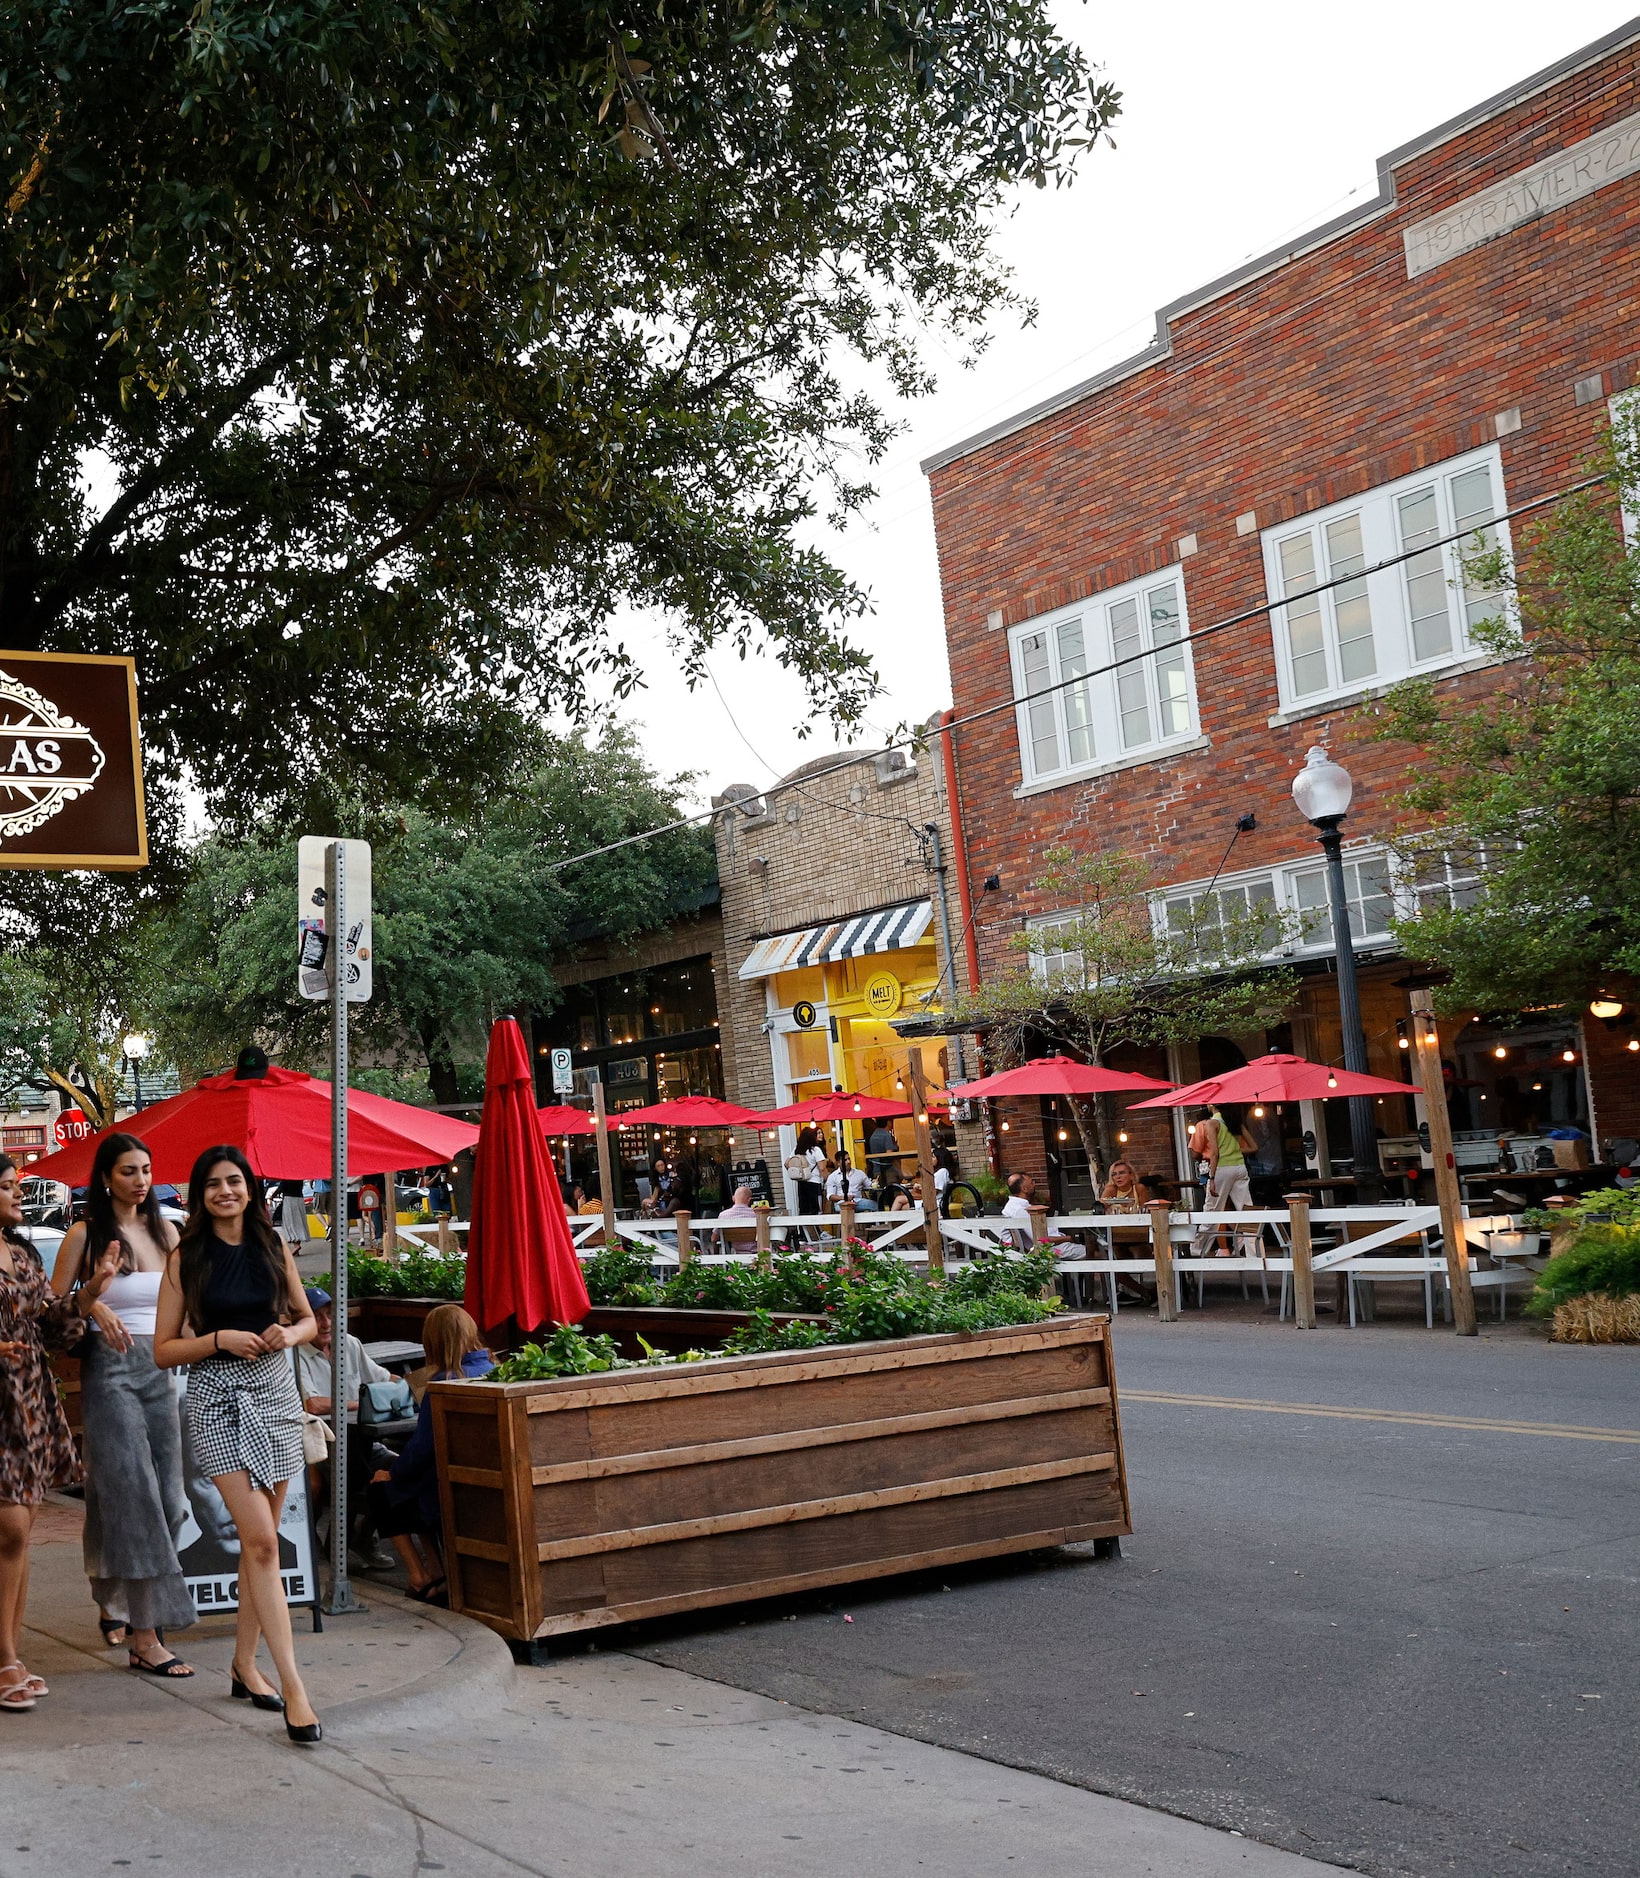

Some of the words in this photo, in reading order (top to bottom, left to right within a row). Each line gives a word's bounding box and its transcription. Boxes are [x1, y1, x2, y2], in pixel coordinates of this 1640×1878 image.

[872, 986, 891, 999] MELT
[56, 1121, 92, 1140] STOP
[186, 1575, 305, 1604] ELCE
